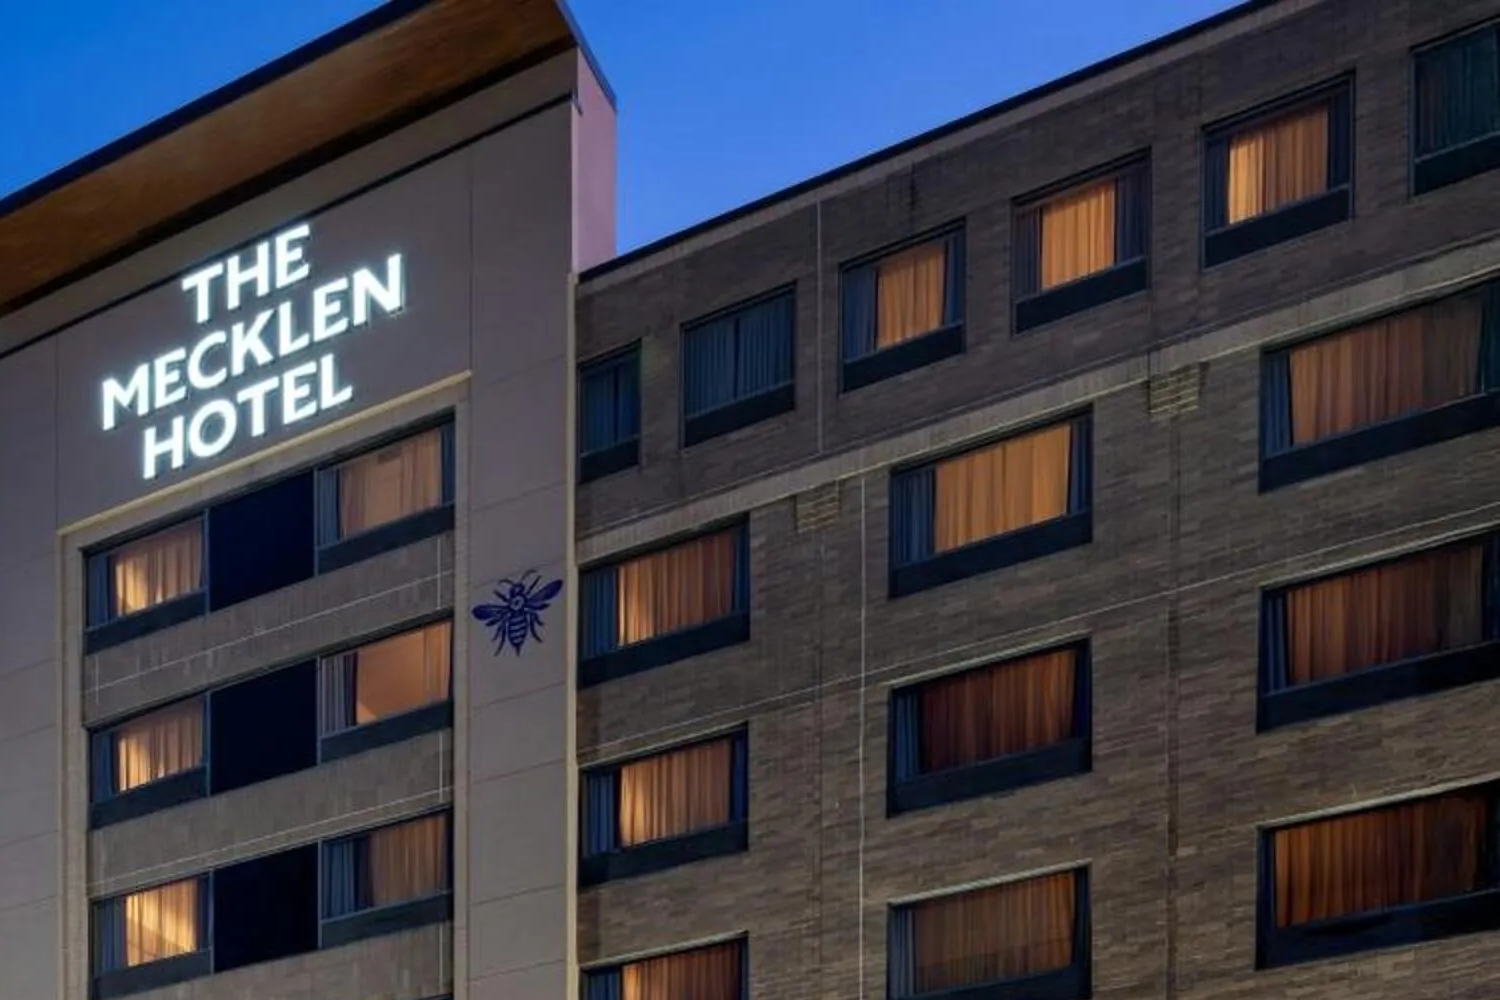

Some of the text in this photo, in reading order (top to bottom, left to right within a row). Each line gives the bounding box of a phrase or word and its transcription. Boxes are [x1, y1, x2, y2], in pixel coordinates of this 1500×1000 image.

[181, 223, 311, 324] THE
[100, 253, 403, 431] MECKLEN
[143, 353, 353, 480] HOTEL
